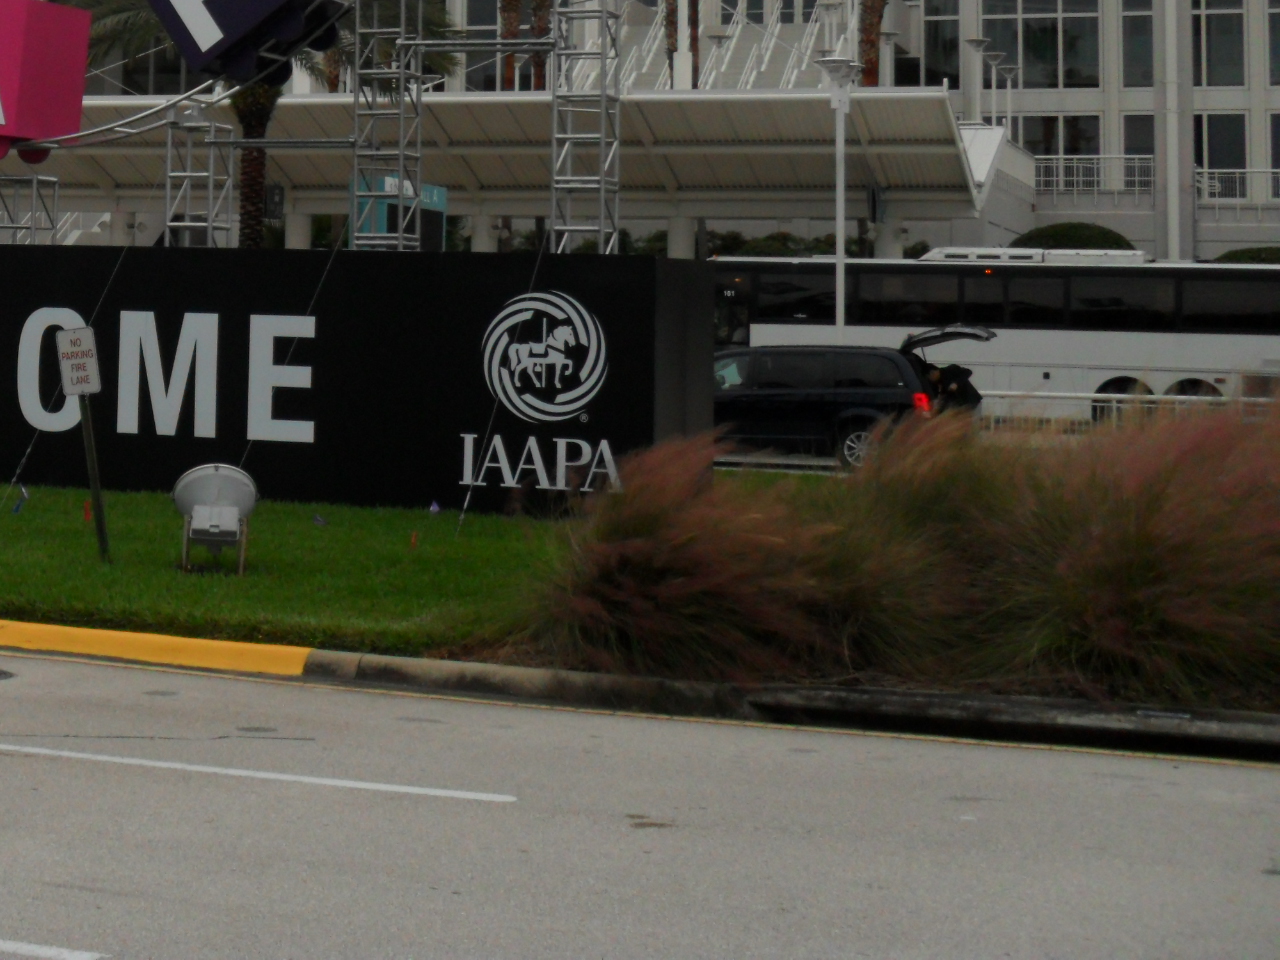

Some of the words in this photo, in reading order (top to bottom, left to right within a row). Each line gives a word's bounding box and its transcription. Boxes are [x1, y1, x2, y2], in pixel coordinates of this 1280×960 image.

[70, 338, 81, 347] NO
[61, 350, 93, 360] PARKING
[71, 362, 87, 372] FIRE
[71, 375, 90, 385] LANE
[459, 433, 624, 494] IAAPA
